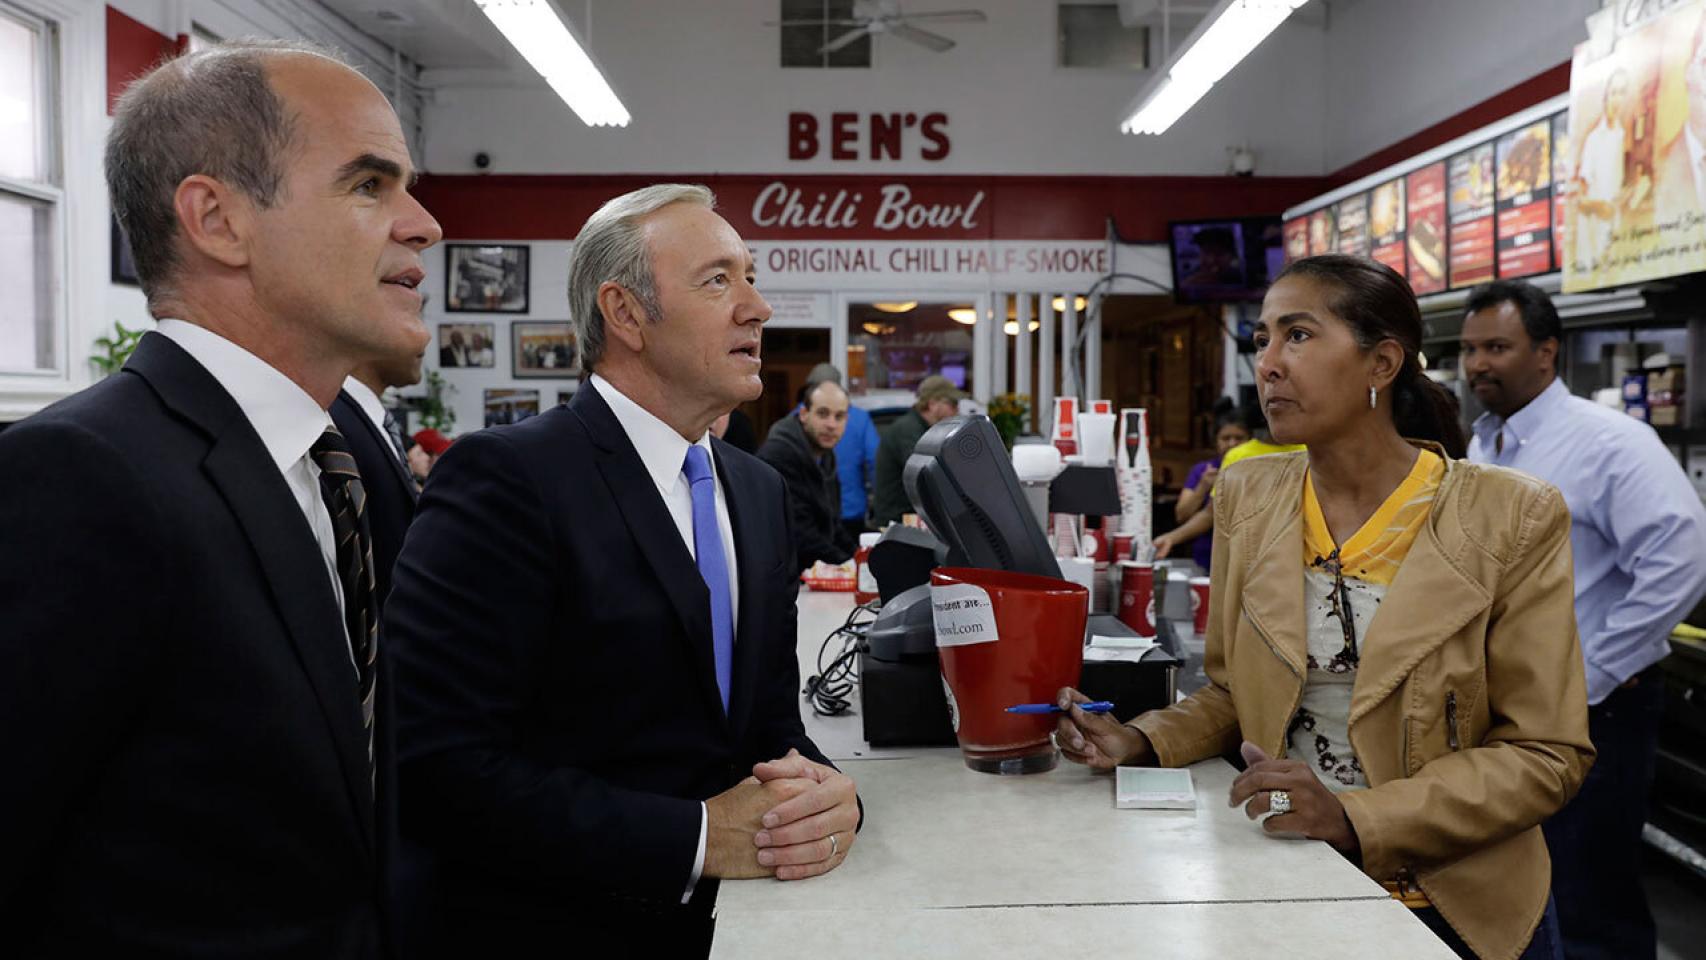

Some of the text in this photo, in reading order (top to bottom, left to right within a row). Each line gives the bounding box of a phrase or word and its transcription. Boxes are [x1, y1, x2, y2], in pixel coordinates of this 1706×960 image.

[788, 112, 951, 161] BEN'S
[752, 181, 985, 230] Chili Bowl
[768, 247, 881, 272] ORIGINAL
[888, 248, 948, 272] CHILI
[956, 248, 1109, 273] HALF-SMOKE
